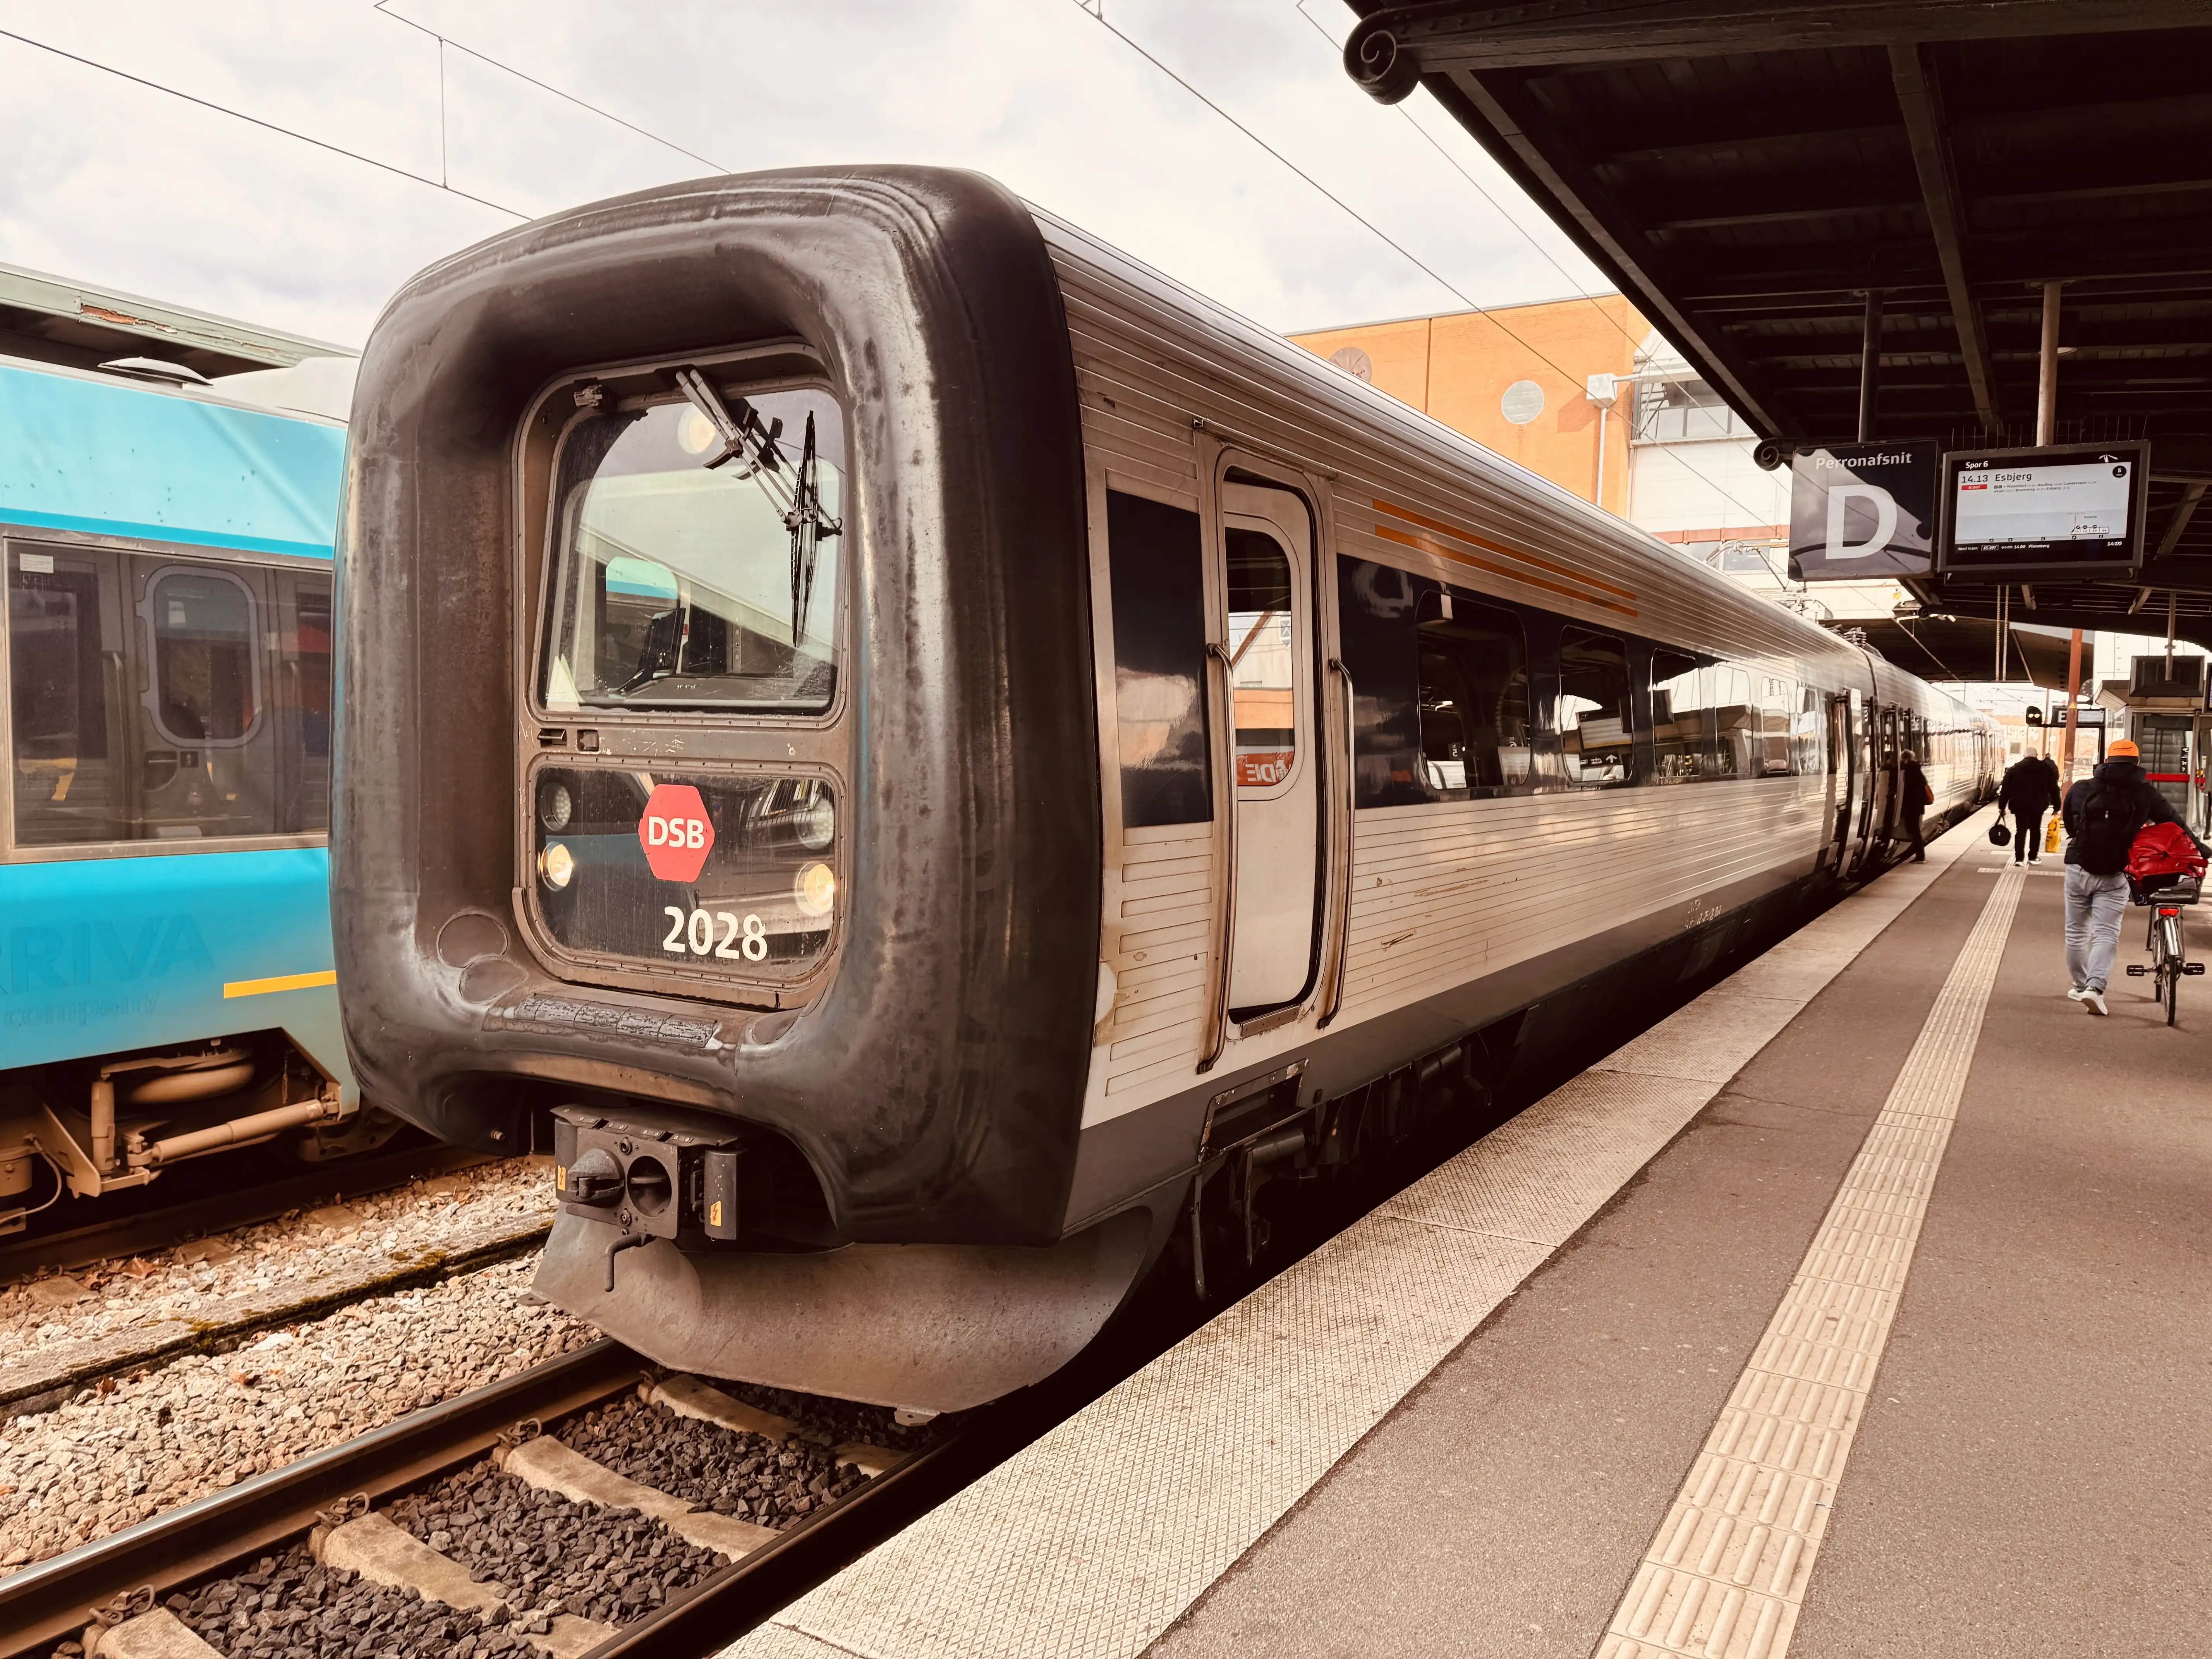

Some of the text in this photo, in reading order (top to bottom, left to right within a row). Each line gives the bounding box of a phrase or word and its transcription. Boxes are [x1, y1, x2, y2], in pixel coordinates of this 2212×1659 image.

[1816, 452, 1912, 470] Perronafsnit
[1965, 462, 1982, 470] Spor
[1962, 473, 2032, 483] 14.13 Esbjerg
[1826, 484, 1898, 560] D
[2058, 711, 2067, 723] E
[648, 816, 704, 849] DSB
[663, 906, 768, 961] 2028
